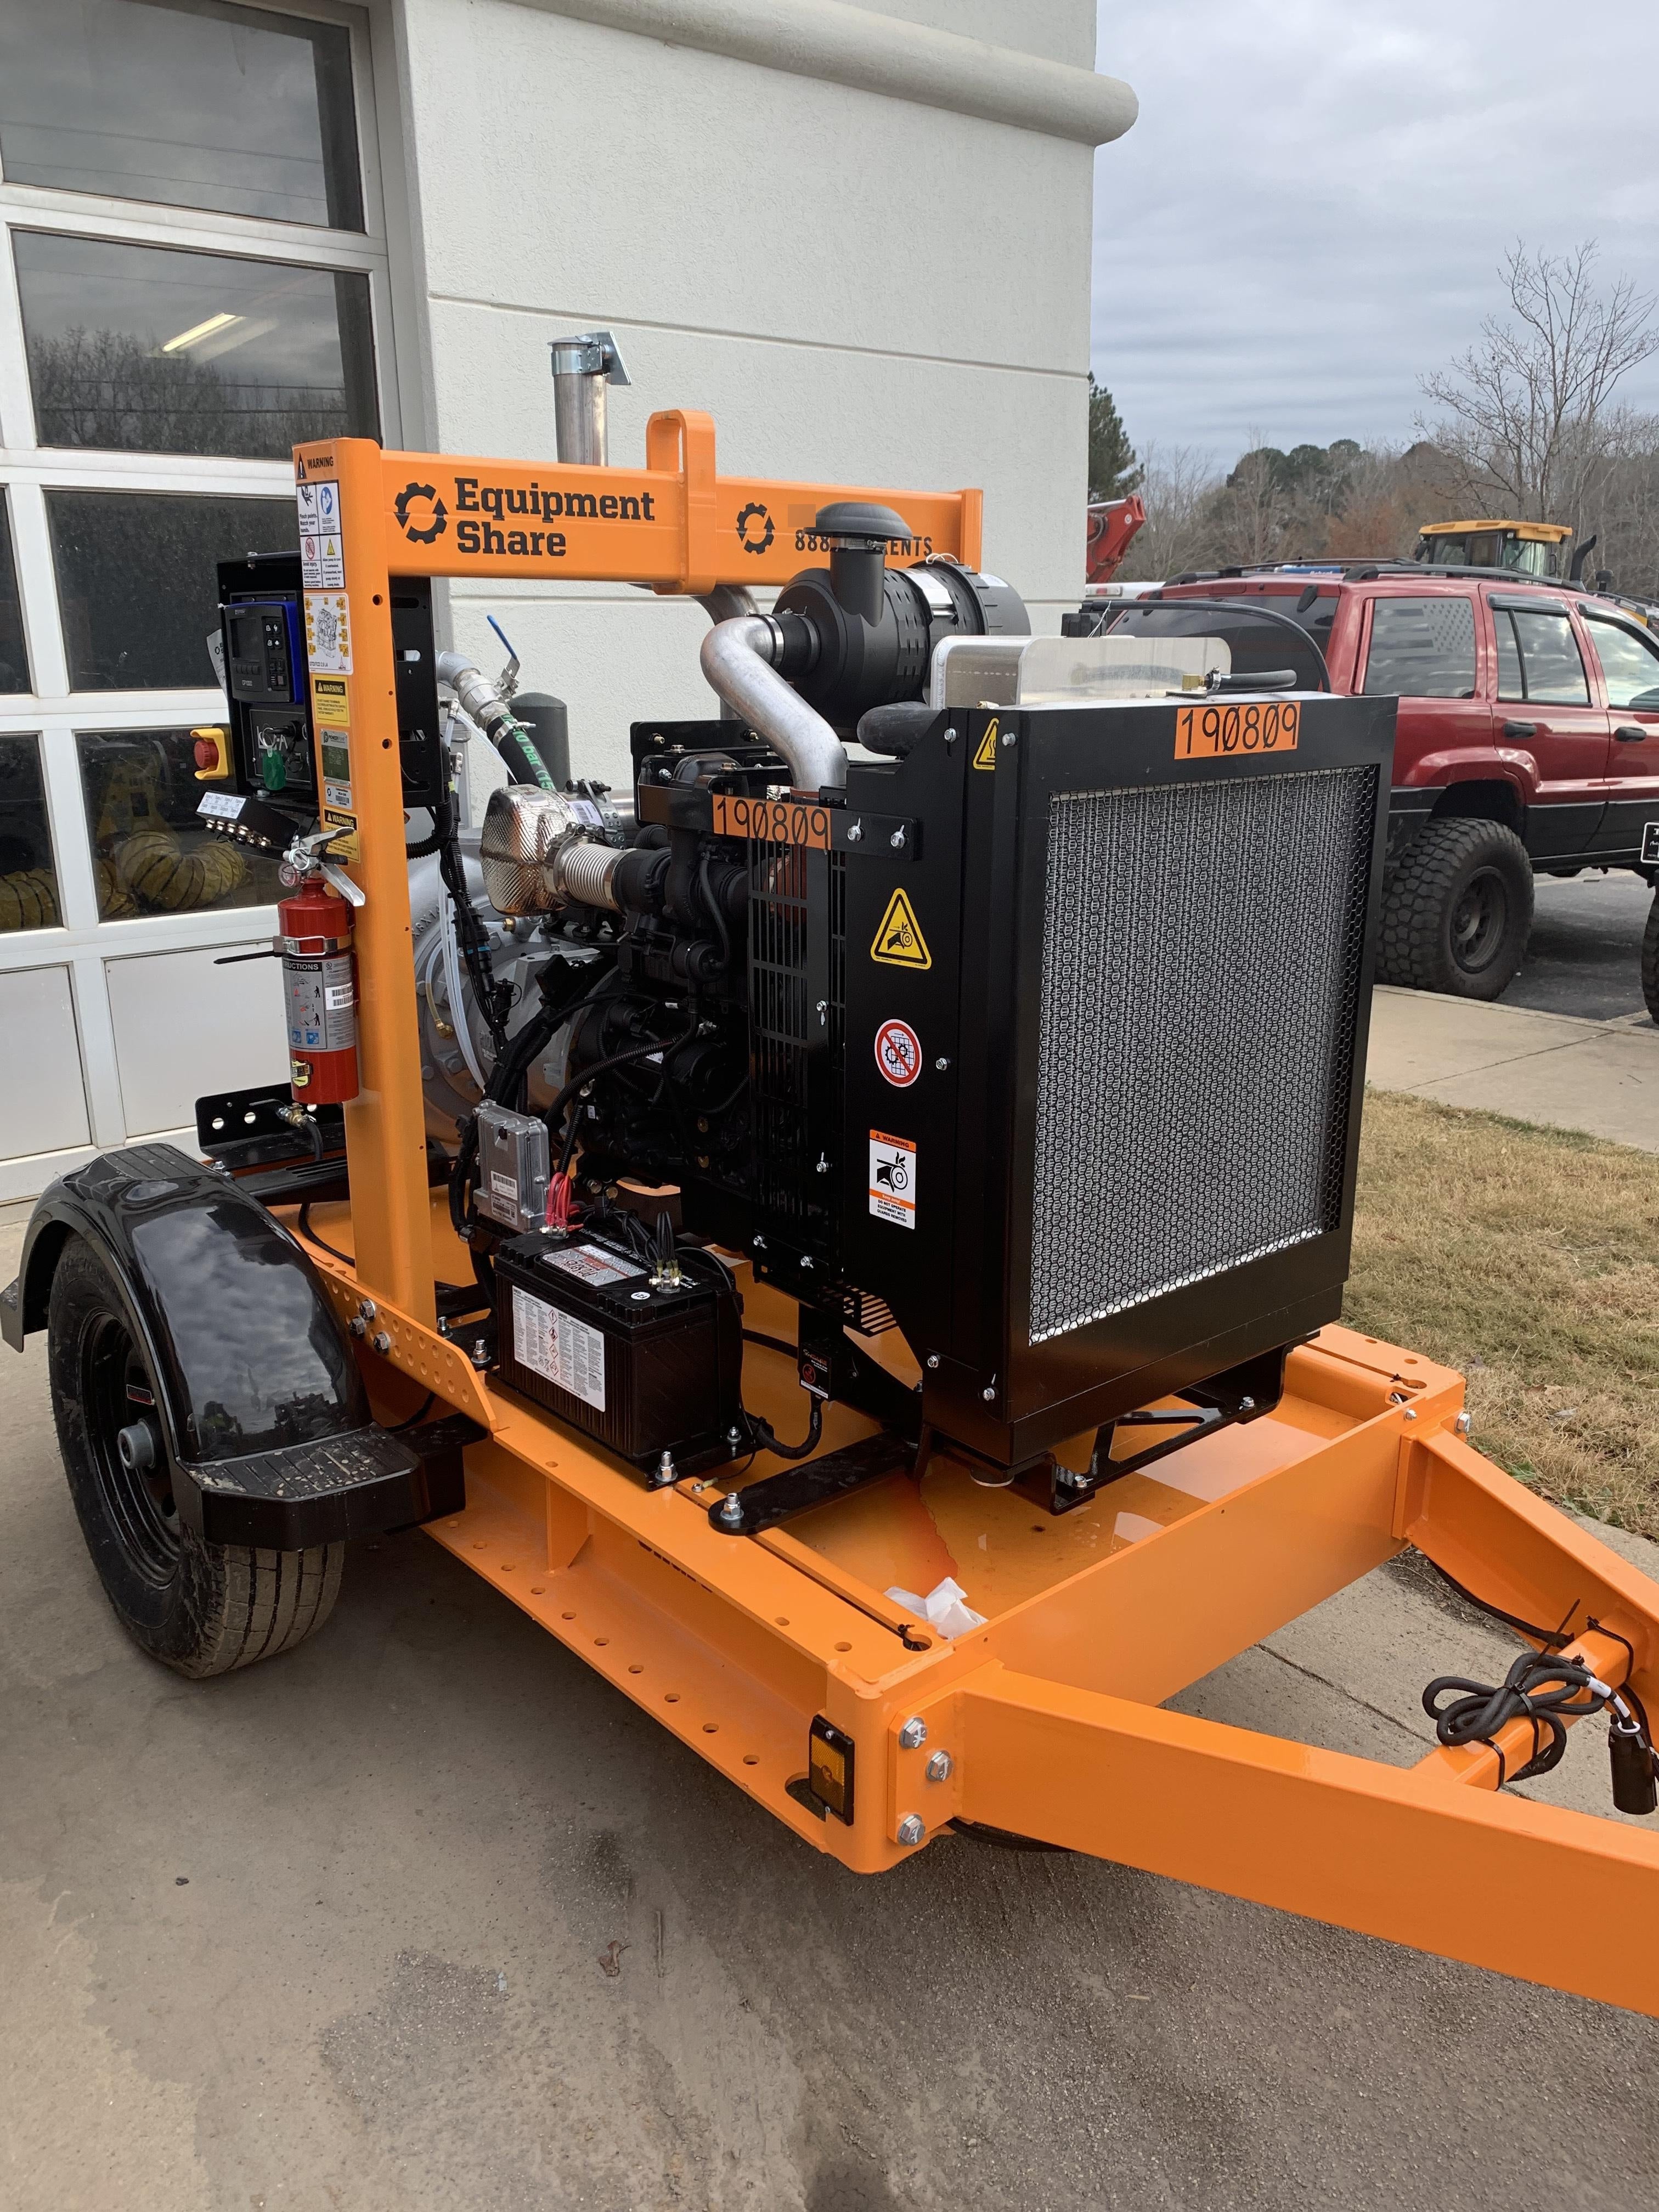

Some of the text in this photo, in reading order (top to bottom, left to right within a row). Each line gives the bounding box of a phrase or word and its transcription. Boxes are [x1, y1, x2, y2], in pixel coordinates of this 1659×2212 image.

[307, 456, 334, 469] WARNING
[454, 477, 655, 523] Equipment
[456, 520, 566, 556] Share
[322, 684, 343, 693] WARNING
[1182, 704, 1298, 754] 190809
[522, 746, 542, 766] bar
[332, 814, 354, 827] WARNING
[716, 797, 829, 850] 190809
[882, 1135, 909, 1148] WARNING
[877, 1204, 896, 1214] EQUIPMENT
[891, 1204, 906, 1212] OPERATE
[890, 1214, 907, 1222] REMOVED
